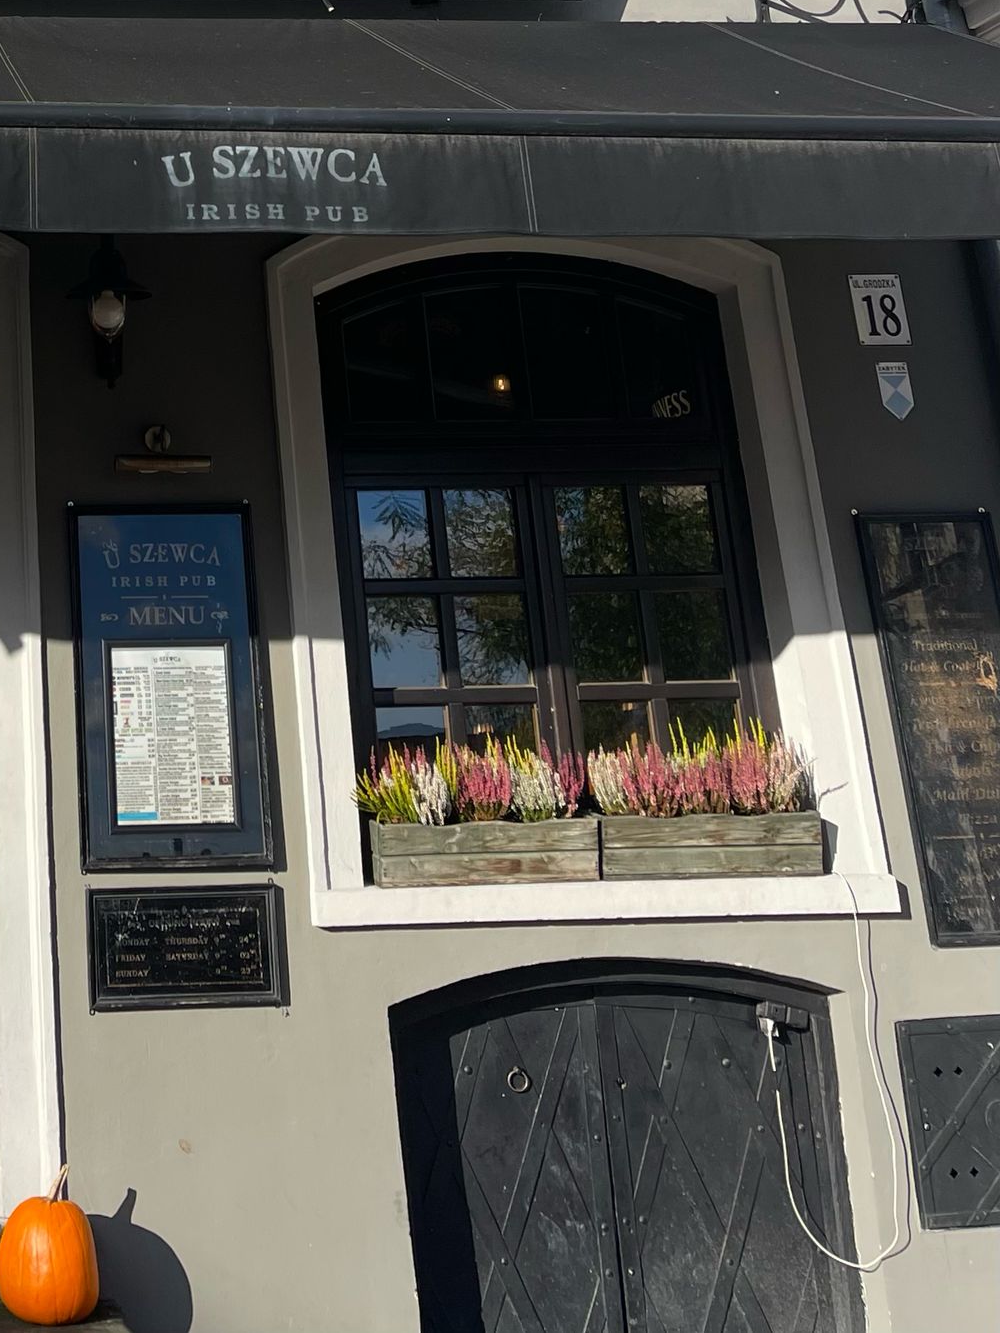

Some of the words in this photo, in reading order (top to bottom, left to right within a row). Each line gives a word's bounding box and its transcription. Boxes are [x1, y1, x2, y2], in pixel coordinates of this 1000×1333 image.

[161, 151, 195, 187] U
[212, 145, 388, 186] SZEWCA
[186, 204, 285, 220] IRISH
[304, 206, 369, 222] PUB
[861, 294, 902, 337] 18
[103, 549, 120, 569] U
[129, 543, 221, 567] SZEWCA
[111, 576, 168, 588] IRISH
[180, 575, 217, 587] PUB
[129, 606, 206, 626] MENU
